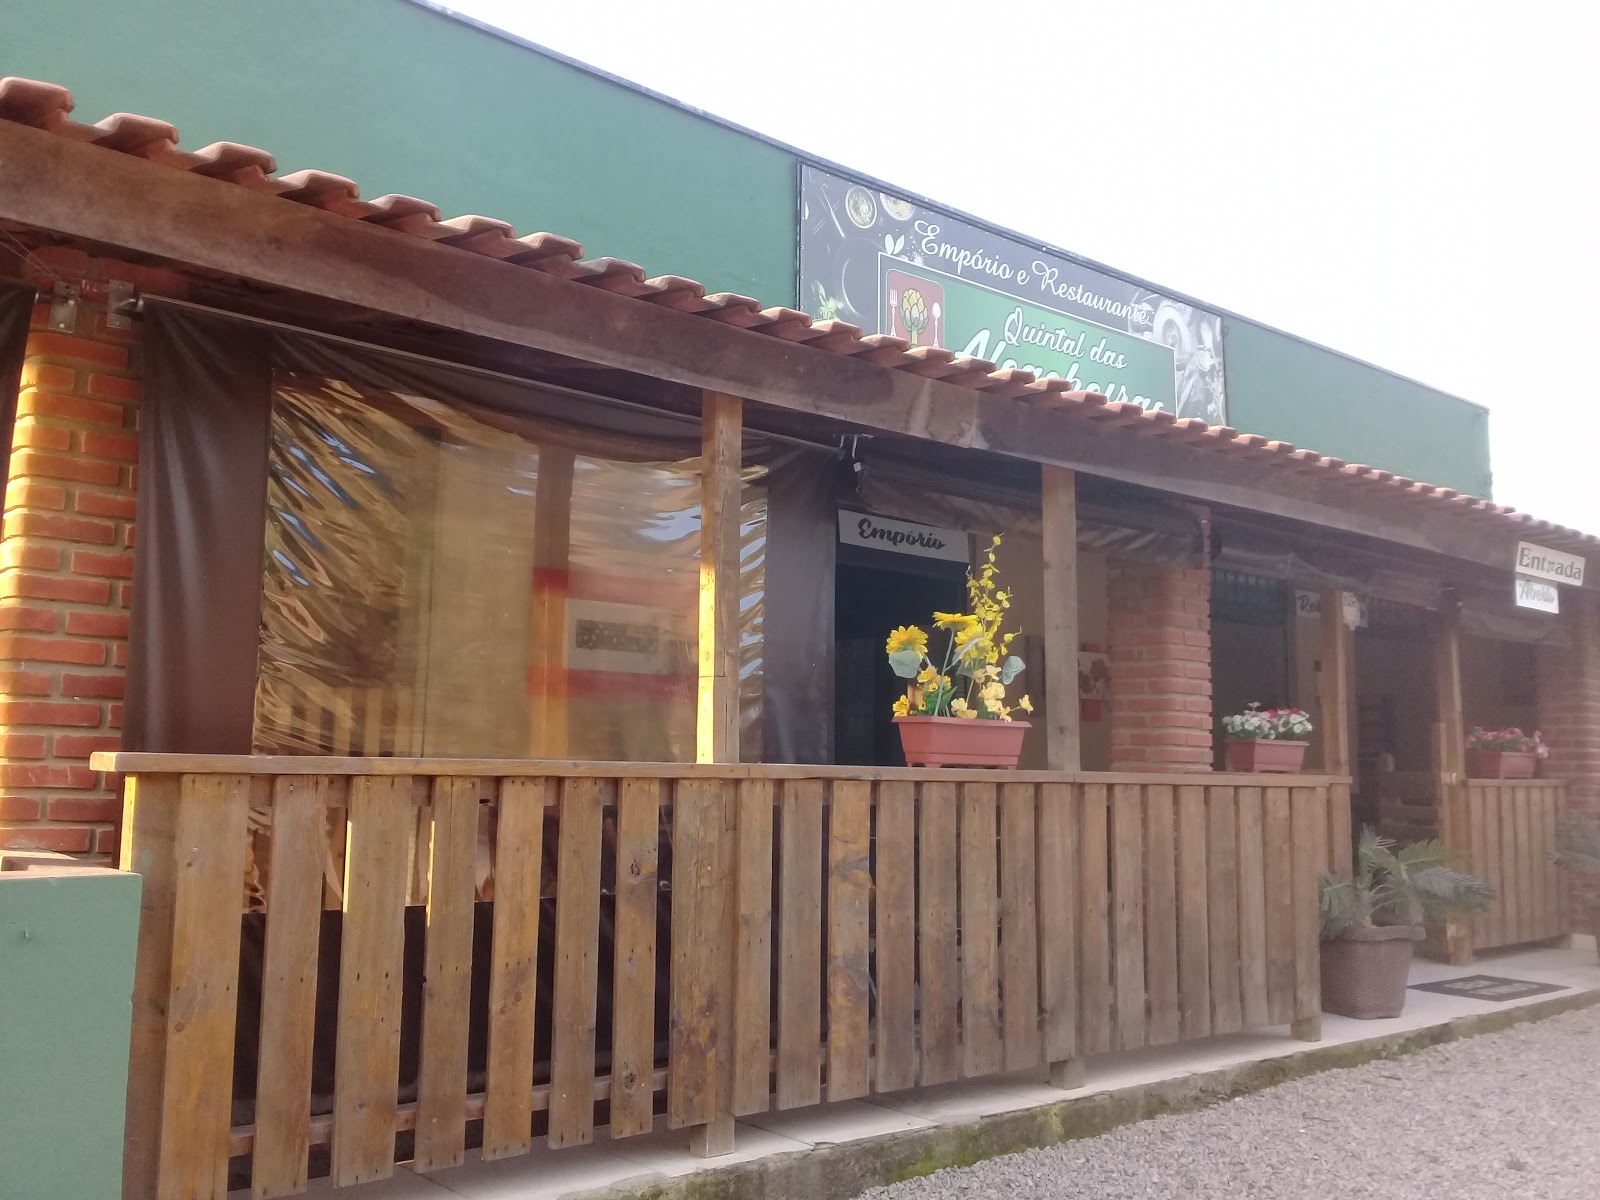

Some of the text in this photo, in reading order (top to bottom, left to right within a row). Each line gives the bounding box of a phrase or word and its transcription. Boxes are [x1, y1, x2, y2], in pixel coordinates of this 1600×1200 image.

[914, 219, 1150, 324] Empório e Restaurante
[1003, 306, 1128, 369] Quintal das
[857, 518, 946, 550] Empório
[1518, 546, 1582, 580] Entrada
